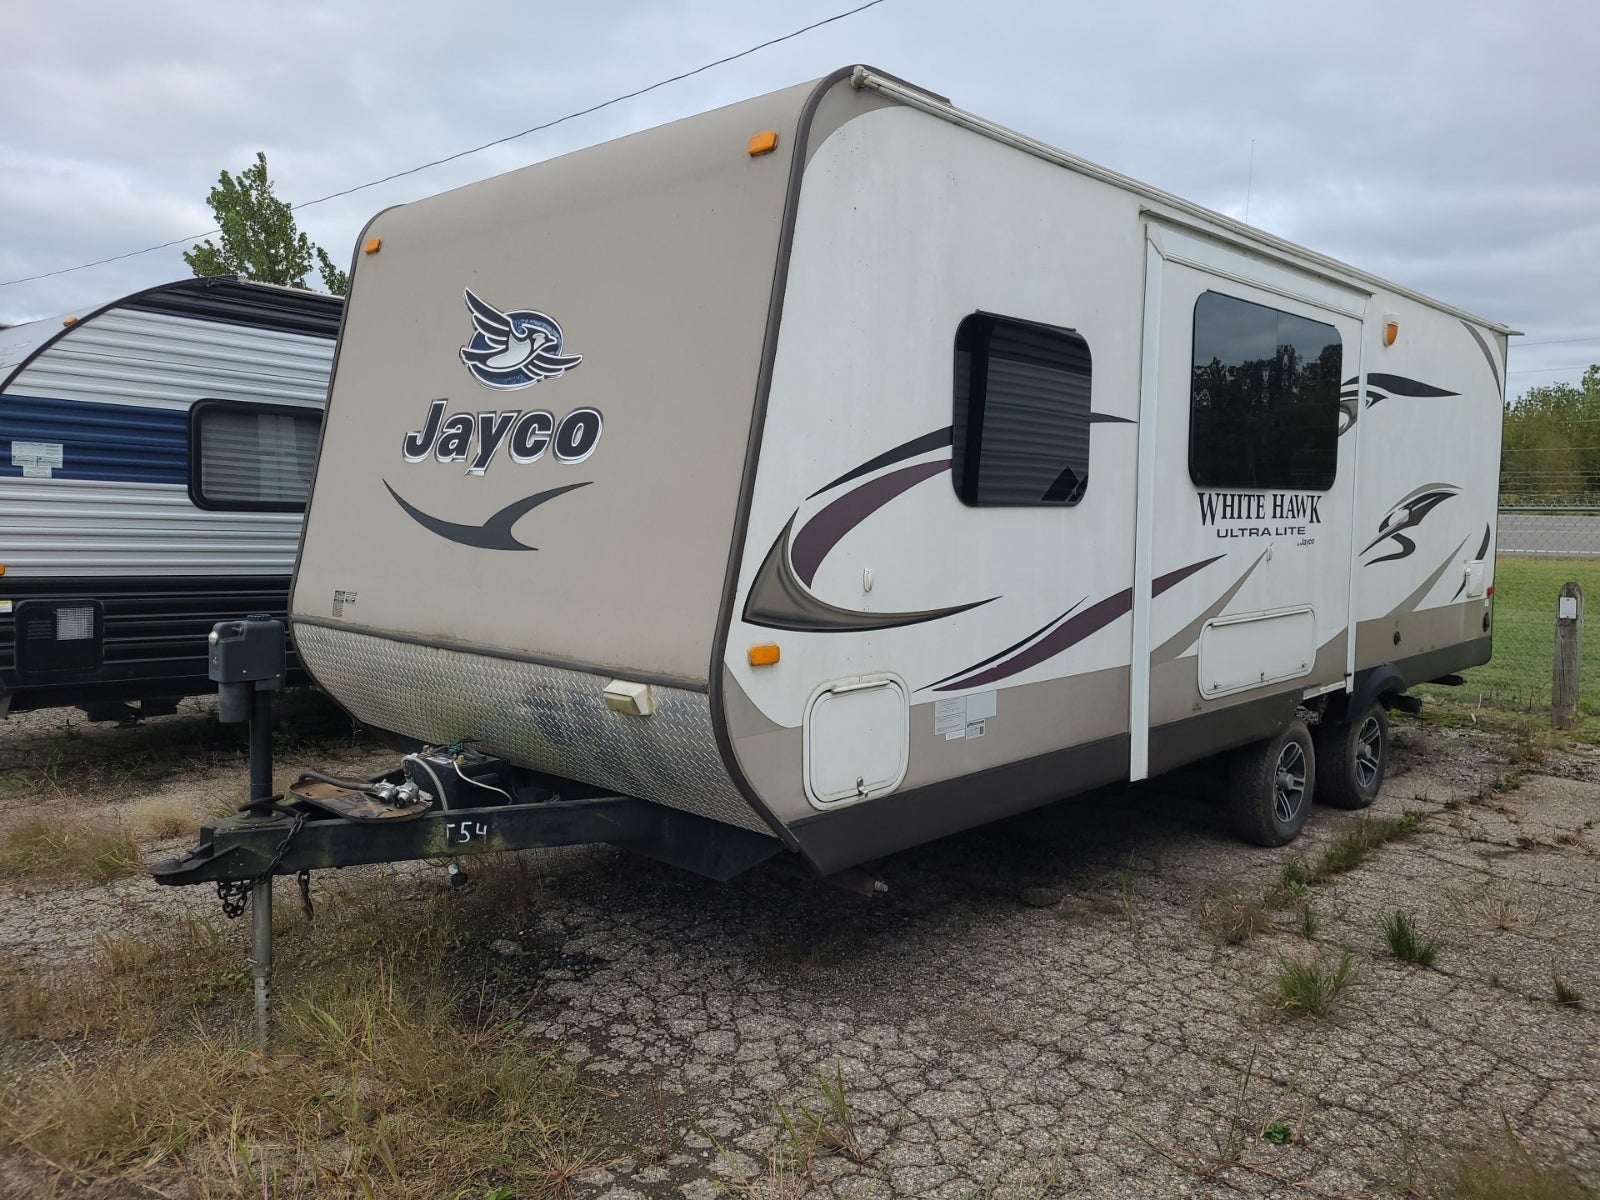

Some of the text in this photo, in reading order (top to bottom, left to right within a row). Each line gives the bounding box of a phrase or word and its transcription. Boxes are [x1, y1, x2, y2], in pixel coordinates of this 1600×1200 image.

[402, 398, 604, 477] Jayco
[1197, 492, 1322, 526] WHITE HAWK
[1216, 526, 1306, 538] ULTRA LITE
